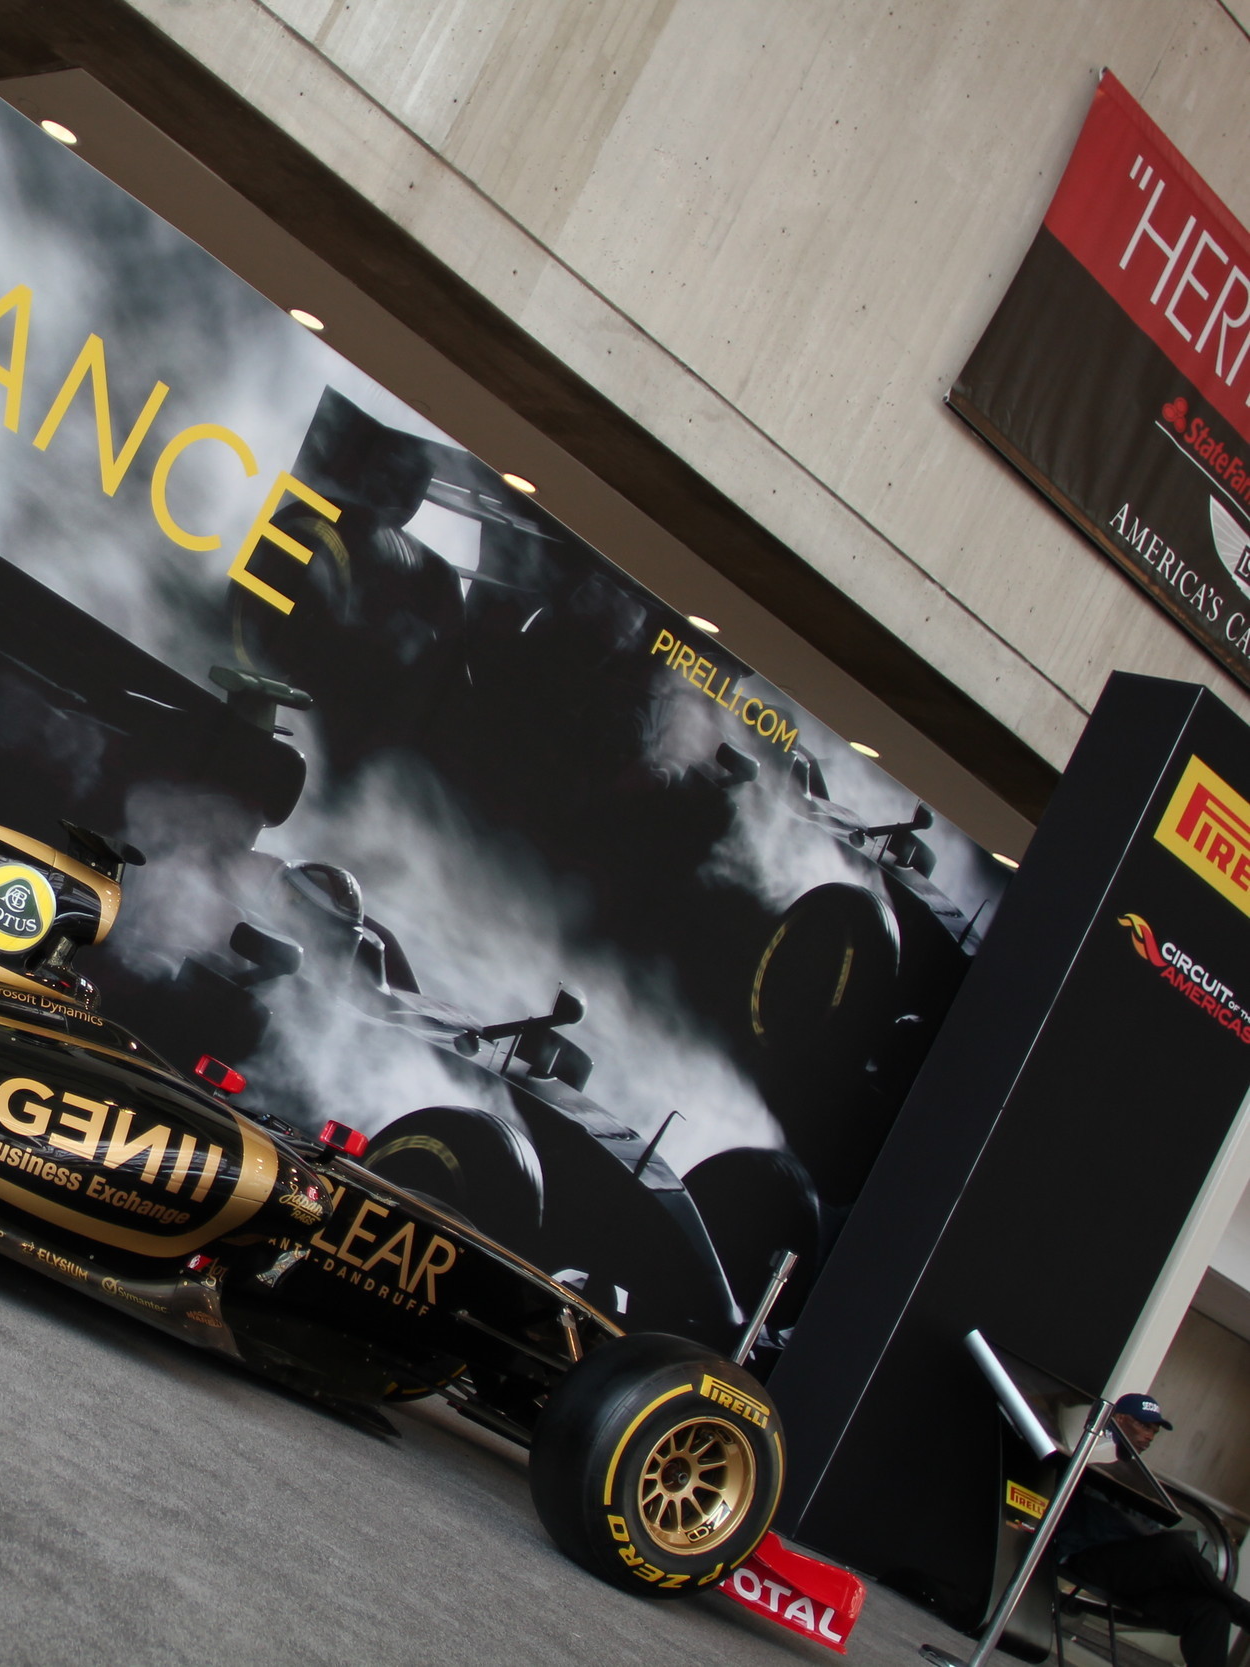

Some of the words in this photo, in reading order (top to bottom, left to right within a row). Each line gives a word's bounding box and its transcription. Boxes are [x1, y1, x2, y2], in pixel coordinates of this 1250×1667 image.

[1109, 503, 1223, 622] AMERICA'S
[651, 629, 799, 752] PIRELLI.COM
[1161, 941, 1234, 1004] CIRCUIT
[1228, 1000, 1240, 1012] OF
[40, 998, 104, 1027] Dynamics
[85, 1173, 191, 1225] Exchange
[279, 1184, 323, 1216] Japan
[37, 1247, 89, 1281] ELYSIUM
[117, 1285, 170, 1314] Symantec
[700, 1373, 771, 1429] PIRELLI
[607, 1514, 691, 1588] ZERO
[697, 1562, 724, 1586] P
[720, 1567, 842, 1643] OTAL
